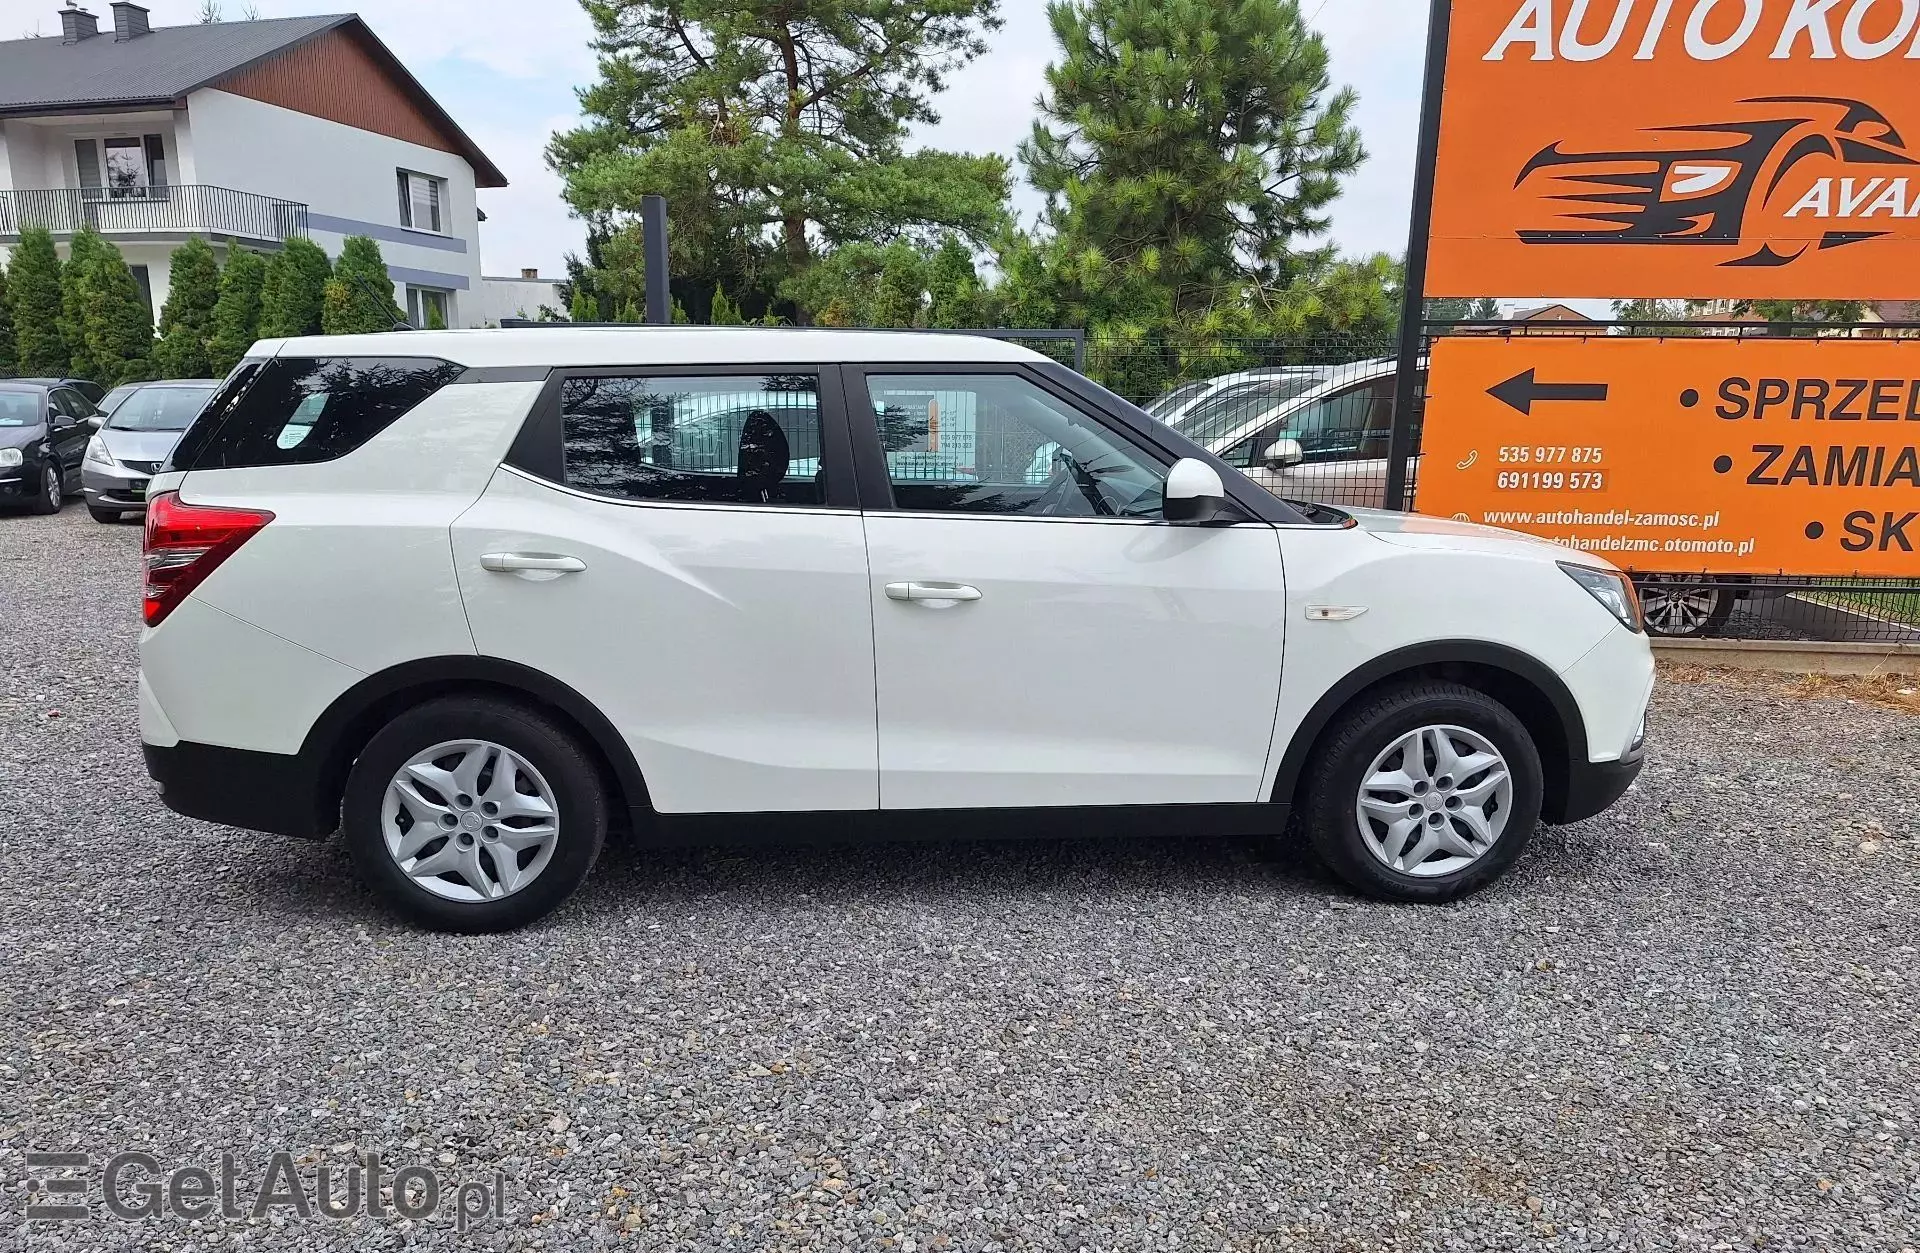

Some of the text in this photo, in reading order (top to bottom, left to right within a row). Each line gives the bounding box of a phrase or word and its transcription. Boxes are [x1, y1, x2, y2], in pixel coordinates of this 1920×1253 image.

[1481, 0, 1763, 61] AUTO
[1783, 177, 1920, 218] AVA
[1498, 446, 1603, 464] 535 977 875
[1746, 444, 1920, 488] ZAMIA
[1569, 472, 1603, 490] 573
[1483, 508, 1721, 531] www.autohandel-zamosc.pl
[1840, 510, 1920, 552] SK
[1552, 534, 1755, 557] tohandelzmc.otomoto.pl
